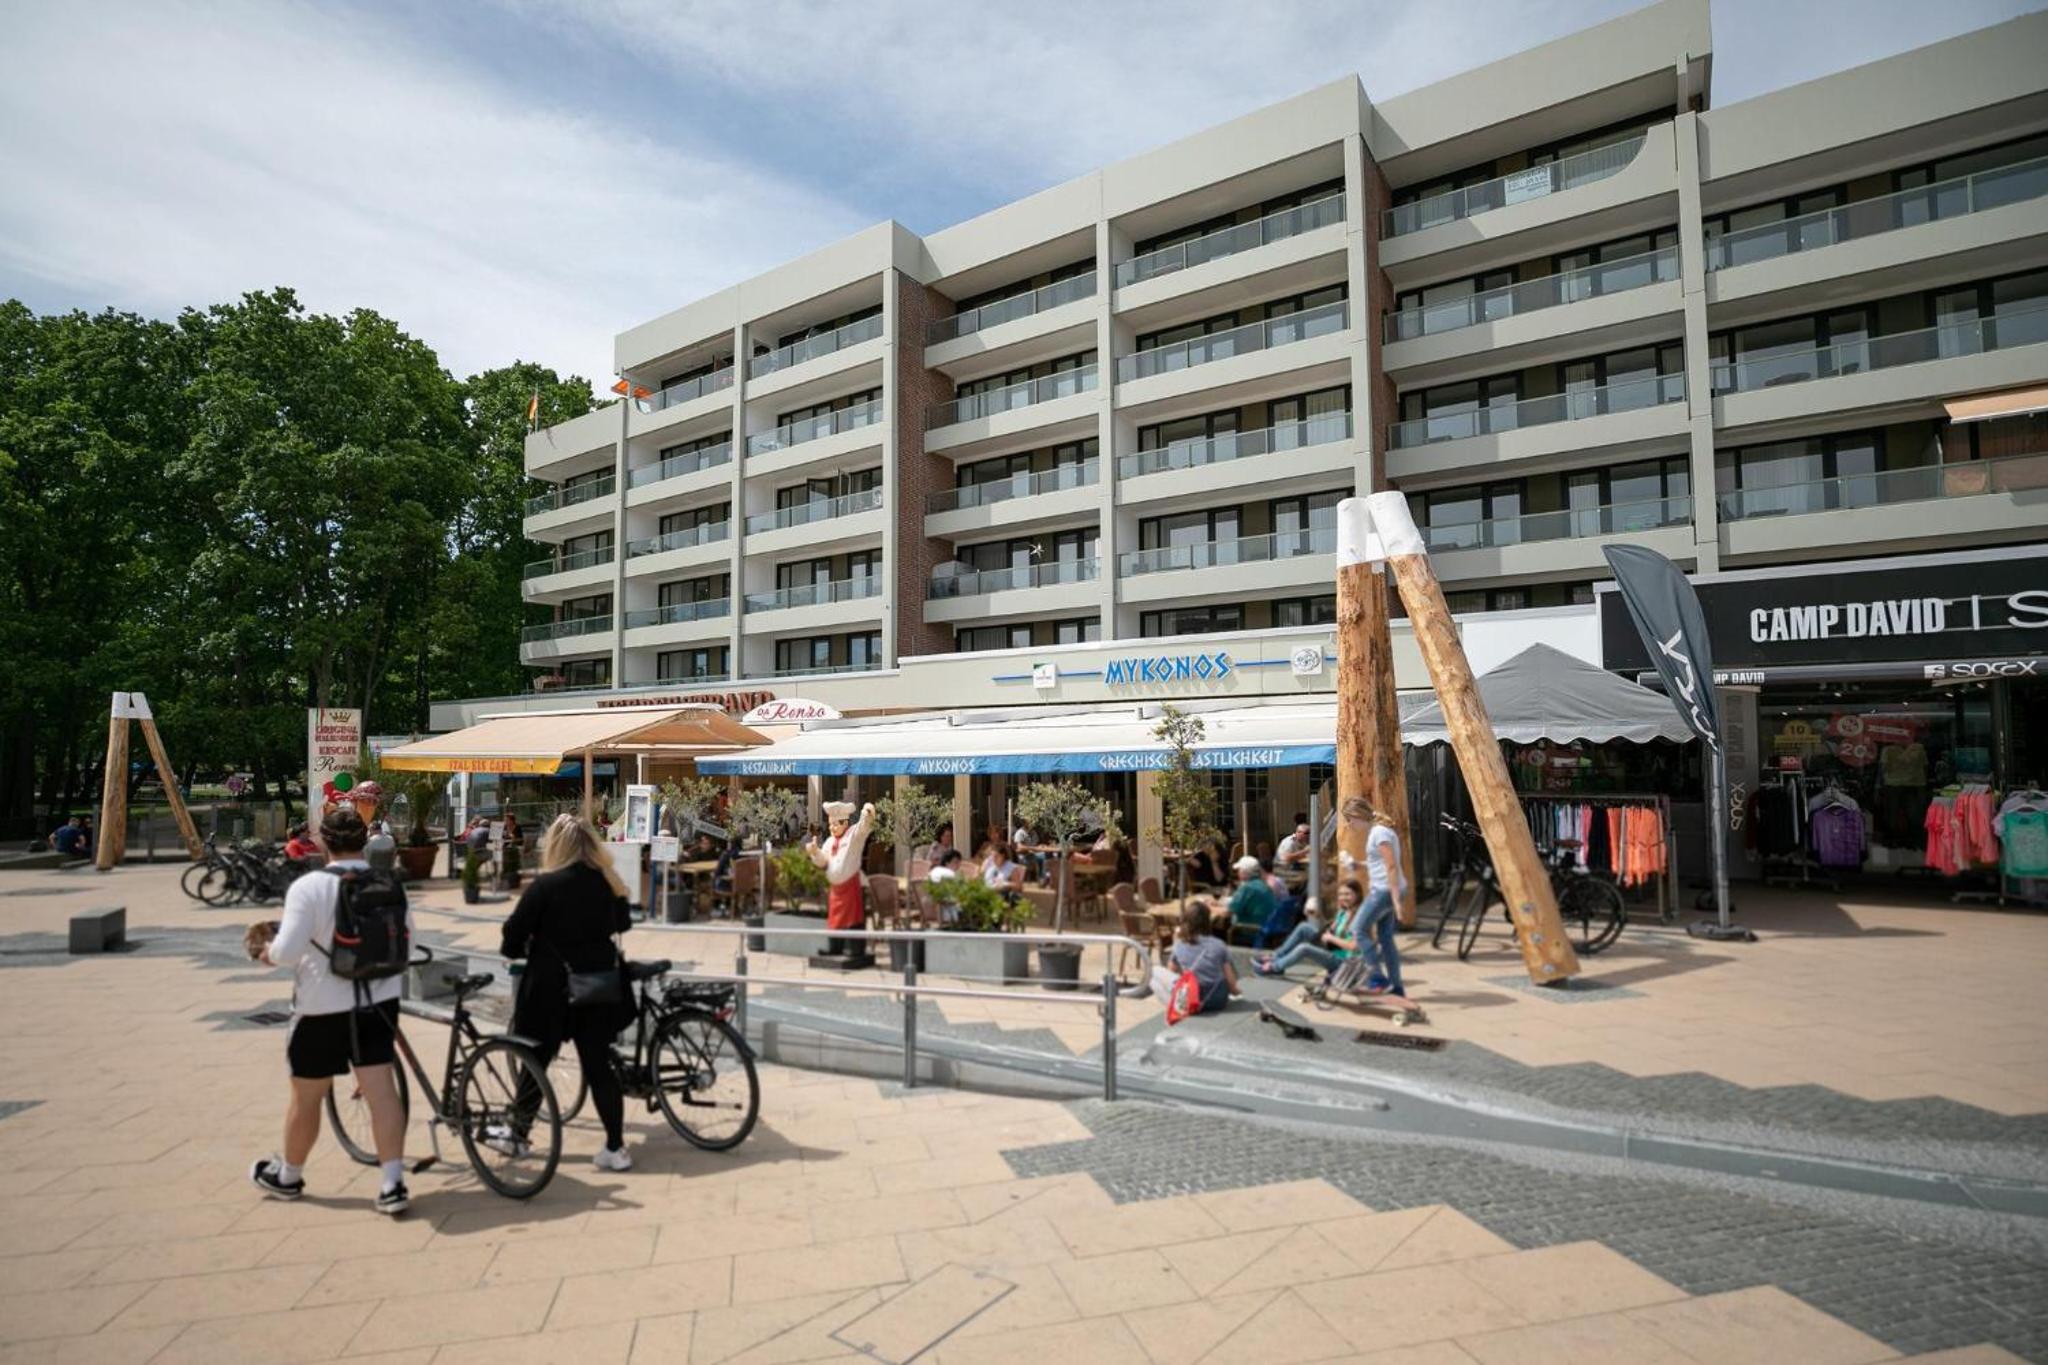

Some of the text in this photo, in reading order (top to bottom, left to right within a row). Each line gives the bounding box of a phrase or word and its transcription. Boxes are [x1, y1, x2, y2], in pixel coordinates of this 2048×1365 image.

[1750, 605, 1839, 642] CAMP
[1847, 598, 1945, 637] DAVID
[1105, 652, 1232, 684] MYKONOS
[1732, 672, 1765, 684] DAVID
[742, 762, 796, 774] RESTAURANT
[918, 758, 976, 774] MYKONOS
[1099, 750, 1283, 769] GRIECHISC ASTLICHKEIT
